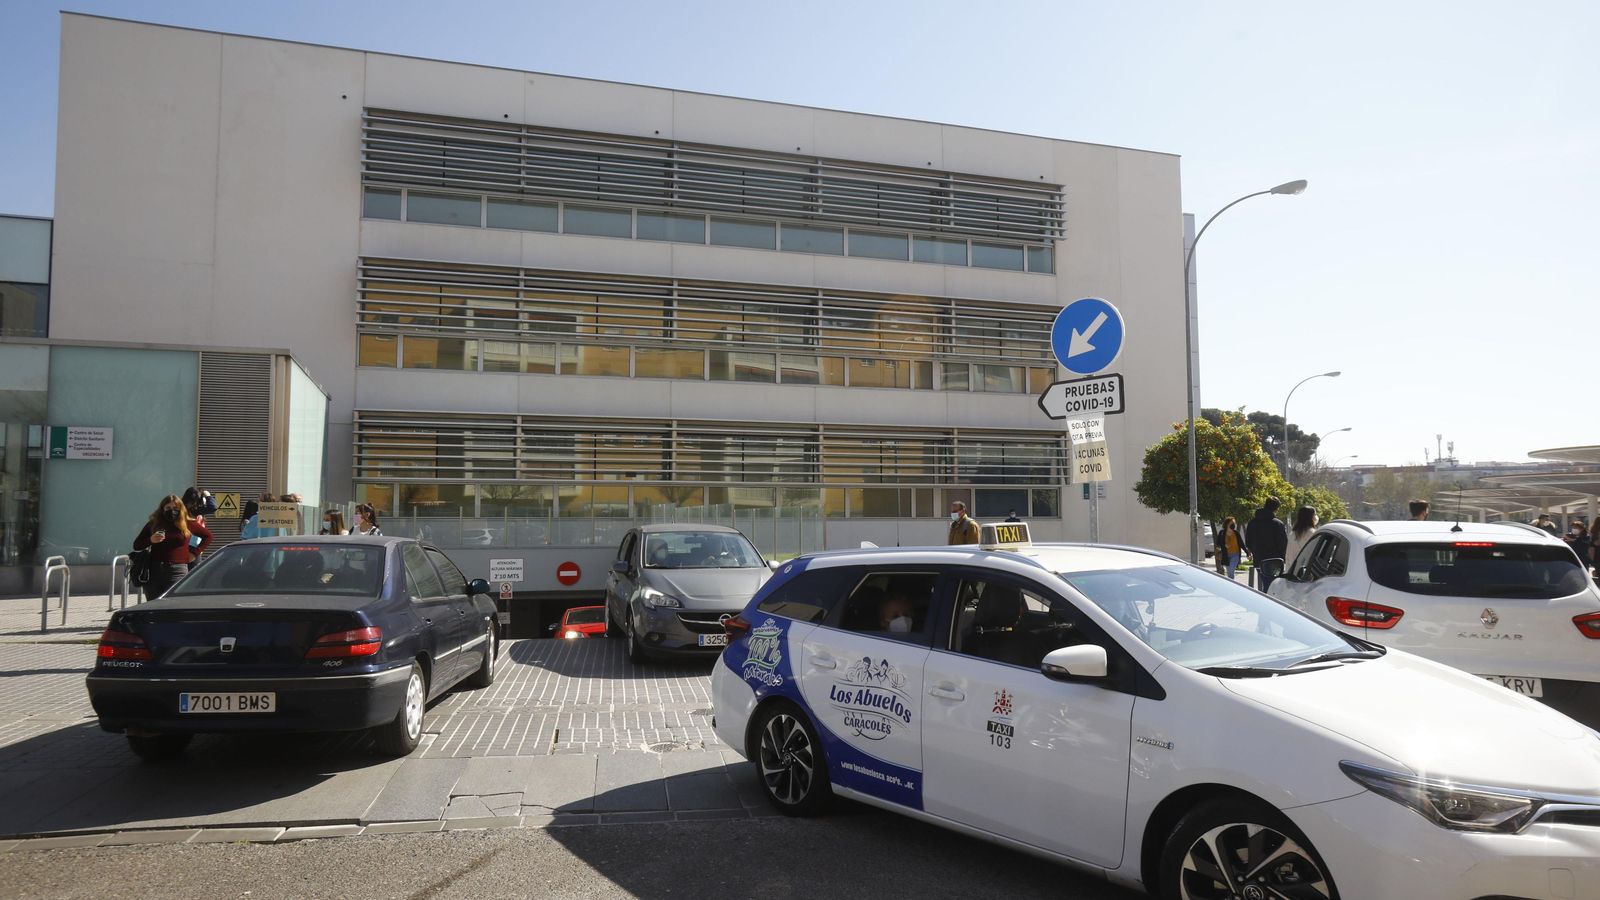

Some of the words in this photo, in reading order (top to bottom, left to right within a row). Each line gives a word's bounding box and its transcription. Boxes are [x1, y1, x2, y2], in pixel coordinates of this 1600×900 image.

[1065, 380, 1115, 398] PRUEBAS
[1065, 396, 1114, 412] COVID-19
[1071, 421, 1086, 430] SOLO
[1086, 420, 1099, 428] CON
[1085, 431, 1103, 439] PREVIA
[1074, 447, 1105, 459] VACUNAS
[1079, 463, 1102, 474] COVID
[997, 527, 1020, 542] TAXI
[706, 635, 728, 645] 3250
[1457, 631, 1524, 640] KADJAR
[748, 637, 782, 663] 100%
[1502, 678, 1535, 694] KRV
[191, 695, 231, 711] 7001
[239, 695, 270, 710] BMS
[830, 685, 852, 704] Los
[853, 688, 912, 723] Abuelos
[844, 716, 892, 735] CARACOLES
[990, 721, 1011, 737] TAXI
[989, 733, 1011, 749] 103
